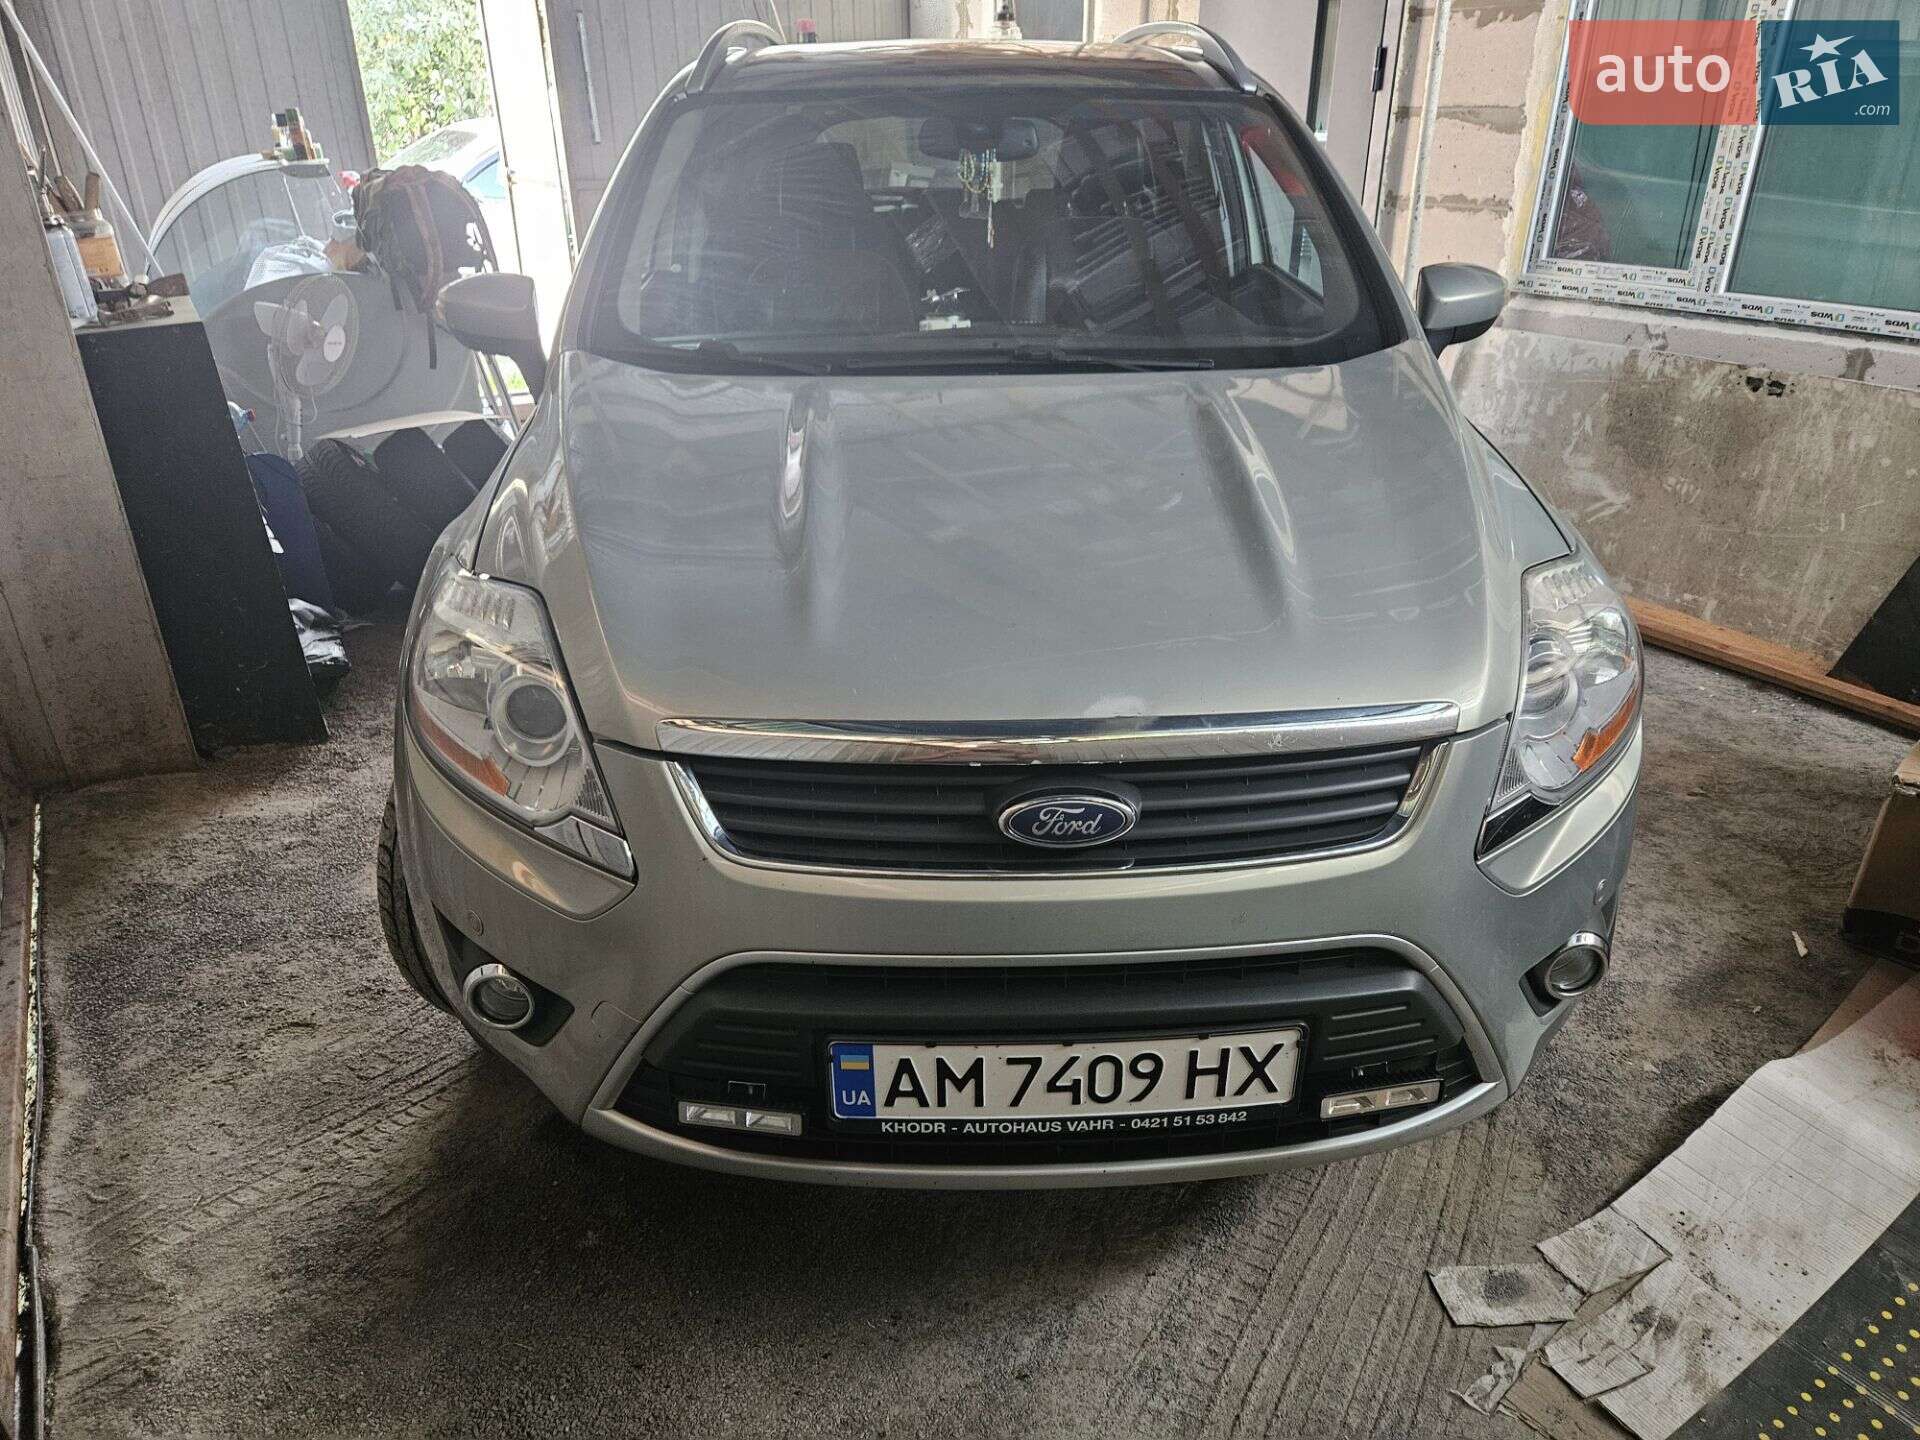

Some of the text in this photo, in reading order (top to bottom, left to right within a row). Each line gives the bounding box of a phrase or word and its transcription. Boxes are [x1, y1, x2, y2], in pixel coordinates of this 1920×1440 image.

[1741, 303, 1764, 314] WDS
[1810, 311, 1835, 322] WDS
[1885, 318, 1910, 330] WDS
[1031, 806, 1103, 836] Ford
[884, 1042, 1285, 1108] AM 7409 HX
[842, 1090, 872, 1106] UA
[881, 1121, 946, 1134] KHODR
[963, 1120, 1062, 1134] AUTOHAUS
[1067, 1118, 1114, 1132] VAHR
[1131, 1116, 1169, 1129] 0421
[1173, 1115, 1194, 1127] 51
[1195, 1114, 1215, 1125] 53
[1218, 1110, 1247, 1123] 842
